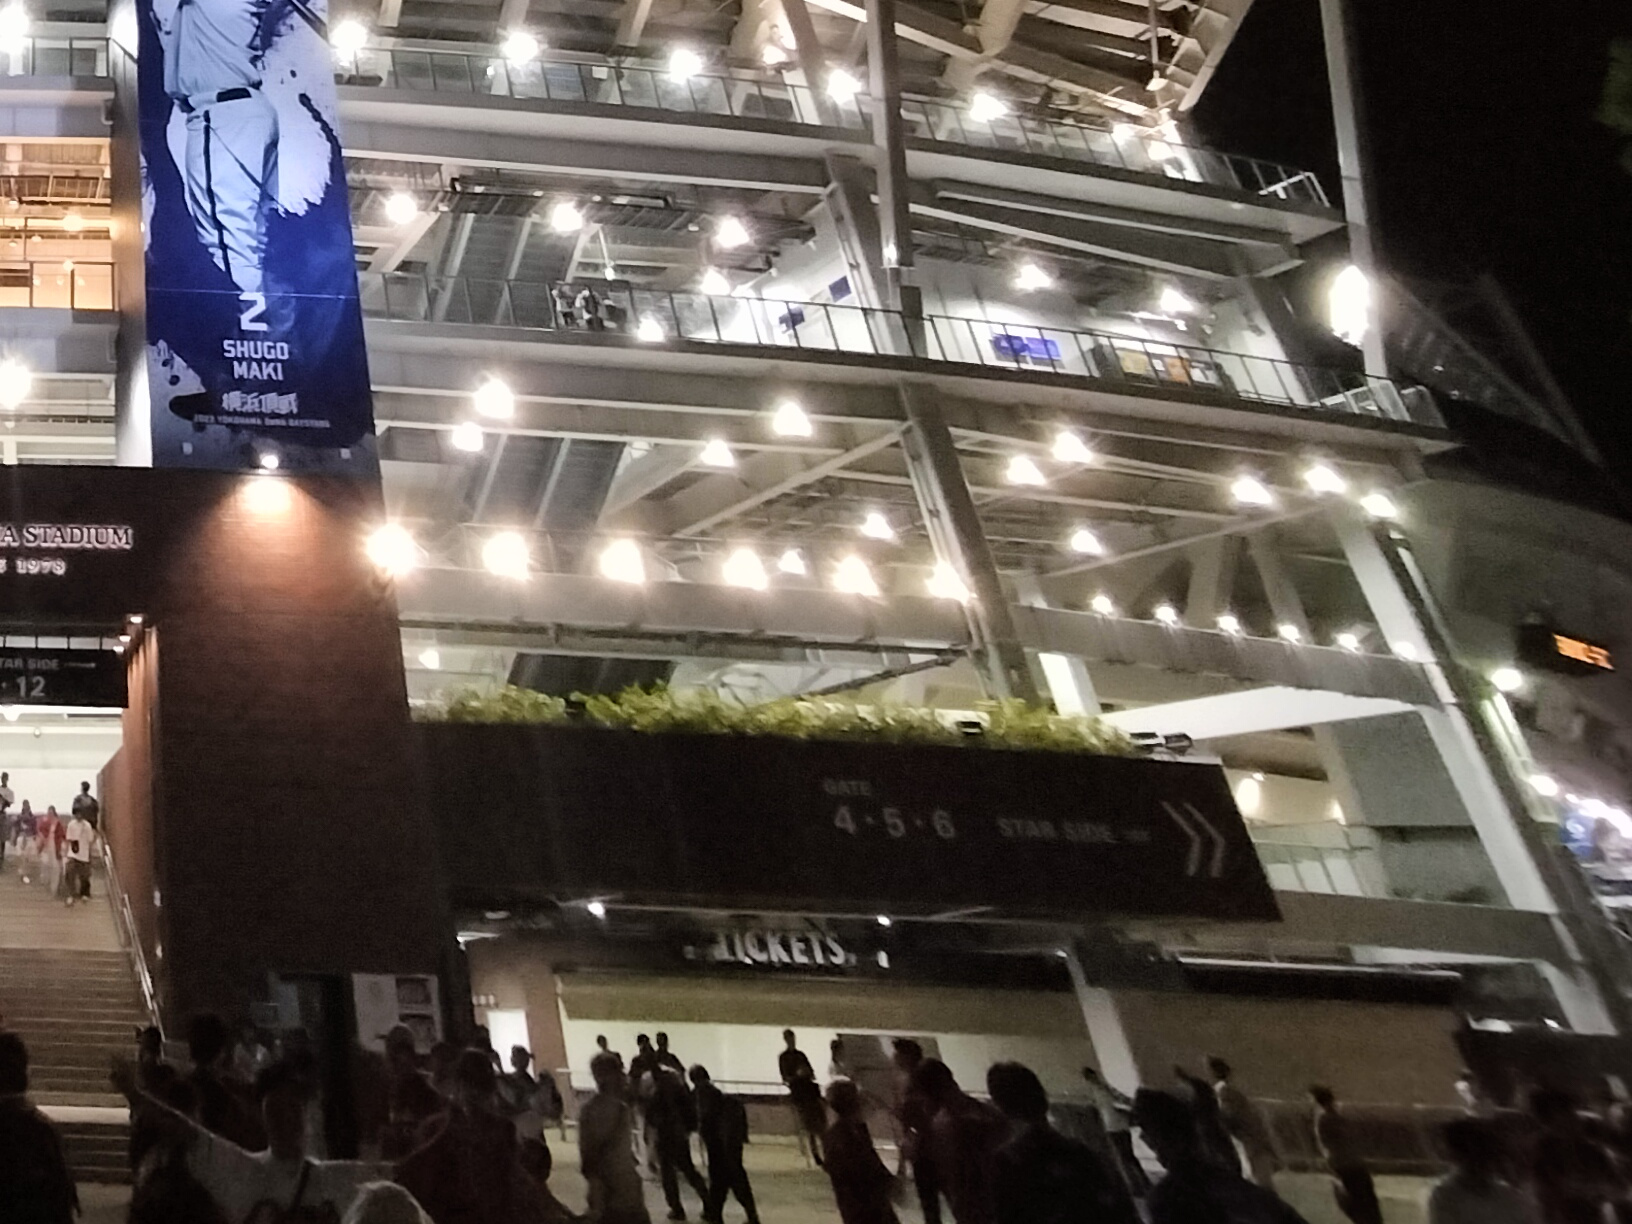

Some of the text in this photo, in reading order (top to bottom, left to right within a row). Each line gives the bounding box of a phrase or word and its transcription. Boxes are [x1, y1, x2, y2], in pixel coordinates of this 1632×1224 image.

[238, 291, 269, 331] 2
[222, 339, 290, 360] SHUGO
[233, 361, 284, 380] MAKI
[22, 525, 133, 549] STADIUM
[16, 558, 66, 575] 1978
[27, 658, 60, 671] SIDE
[16, 675, 46, 698] 12
[822, 778, 871, 796] GATE
[996, 817, 1057, 839] STAR
[713, 930, 846, 965] TICKETS
